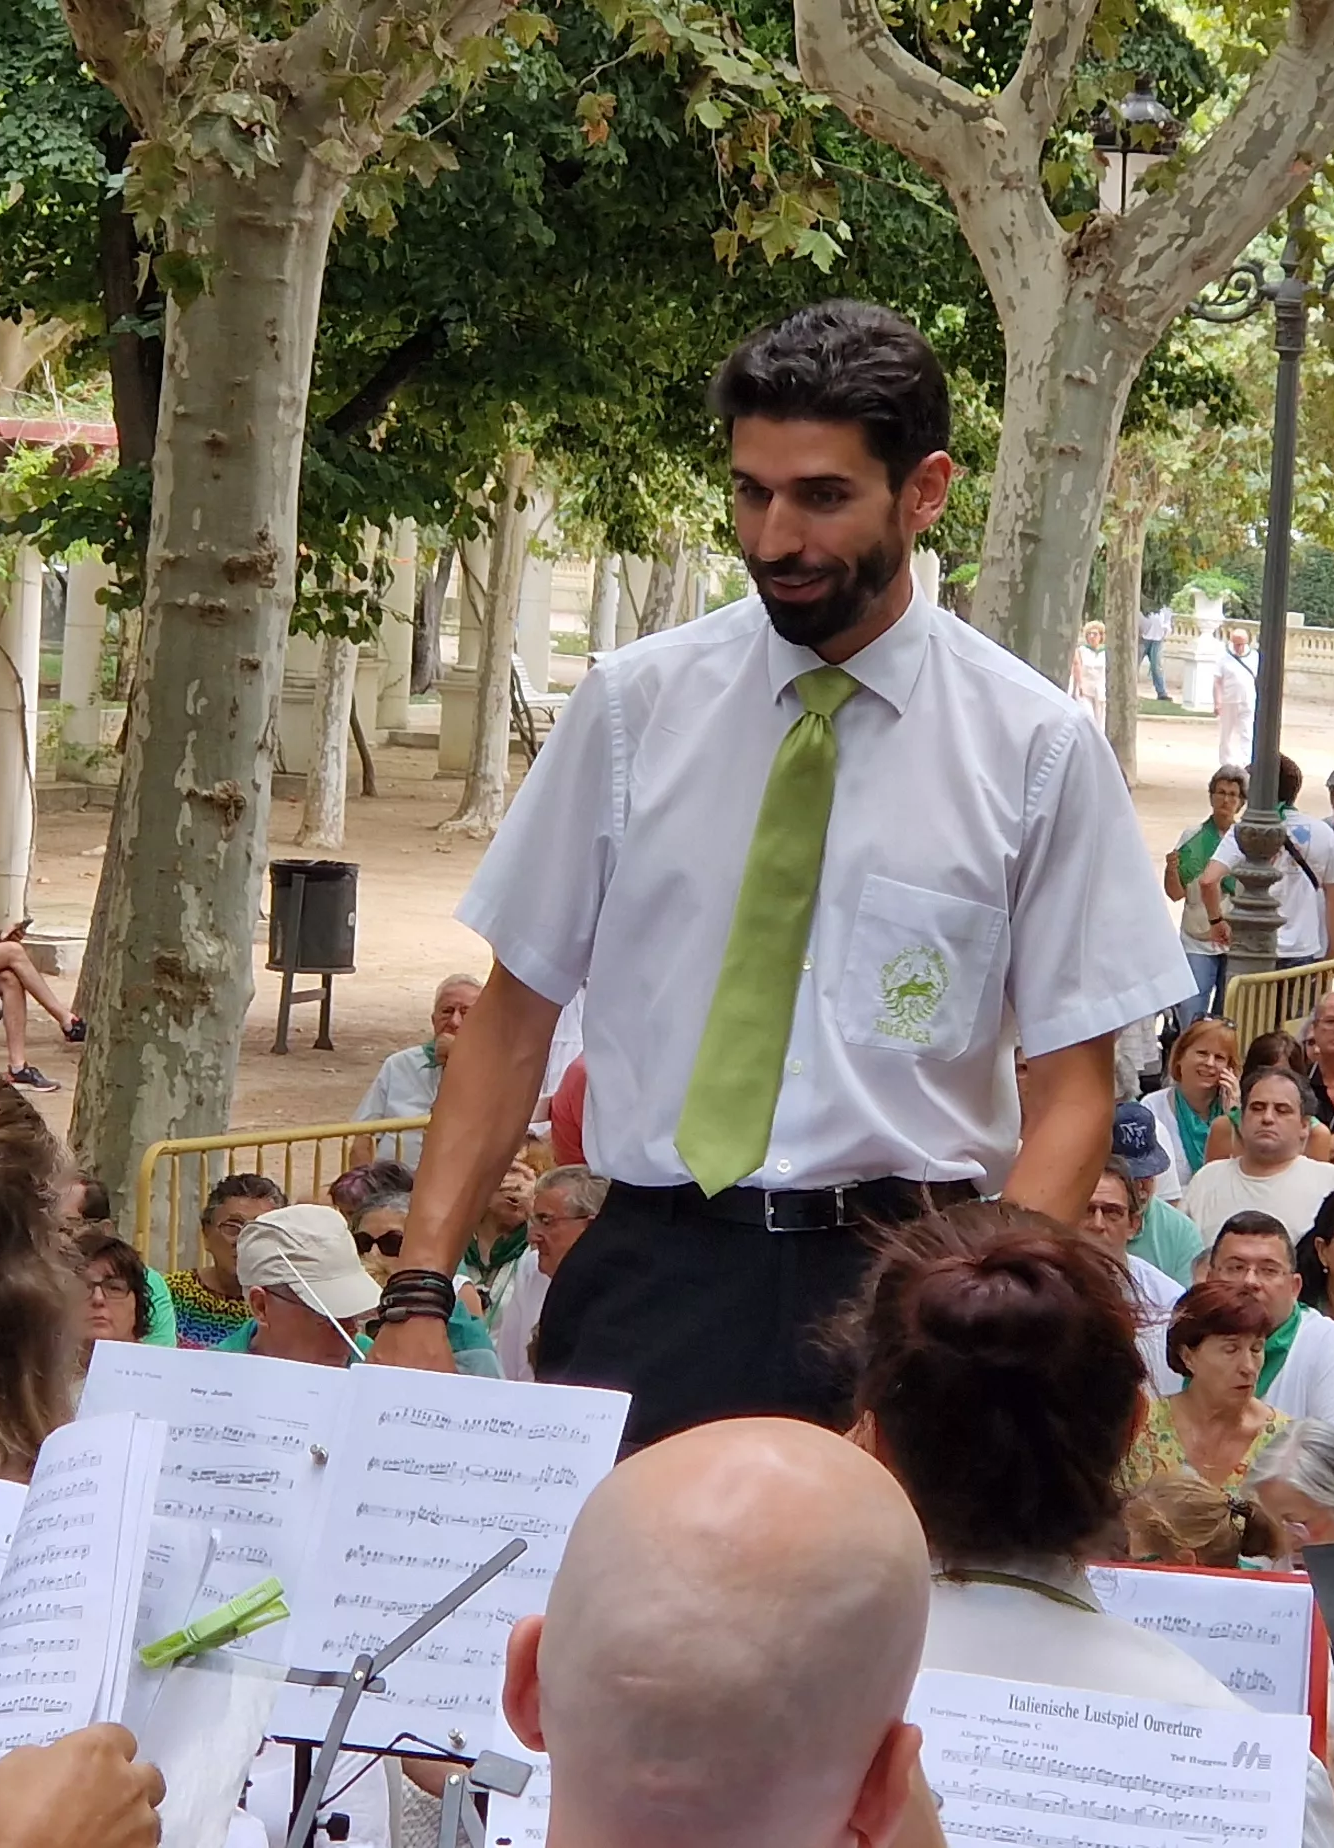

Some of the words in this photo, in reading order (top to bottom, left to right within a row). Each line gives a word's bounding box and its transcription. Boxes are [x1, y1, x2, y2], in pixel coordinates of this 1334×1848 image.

[1008, 1693, 1080, 1719] Italienische
[1083, 1704, 1140, 1730] Lustspiel
[1143, 1713, 1204, 1739] Ouverture
